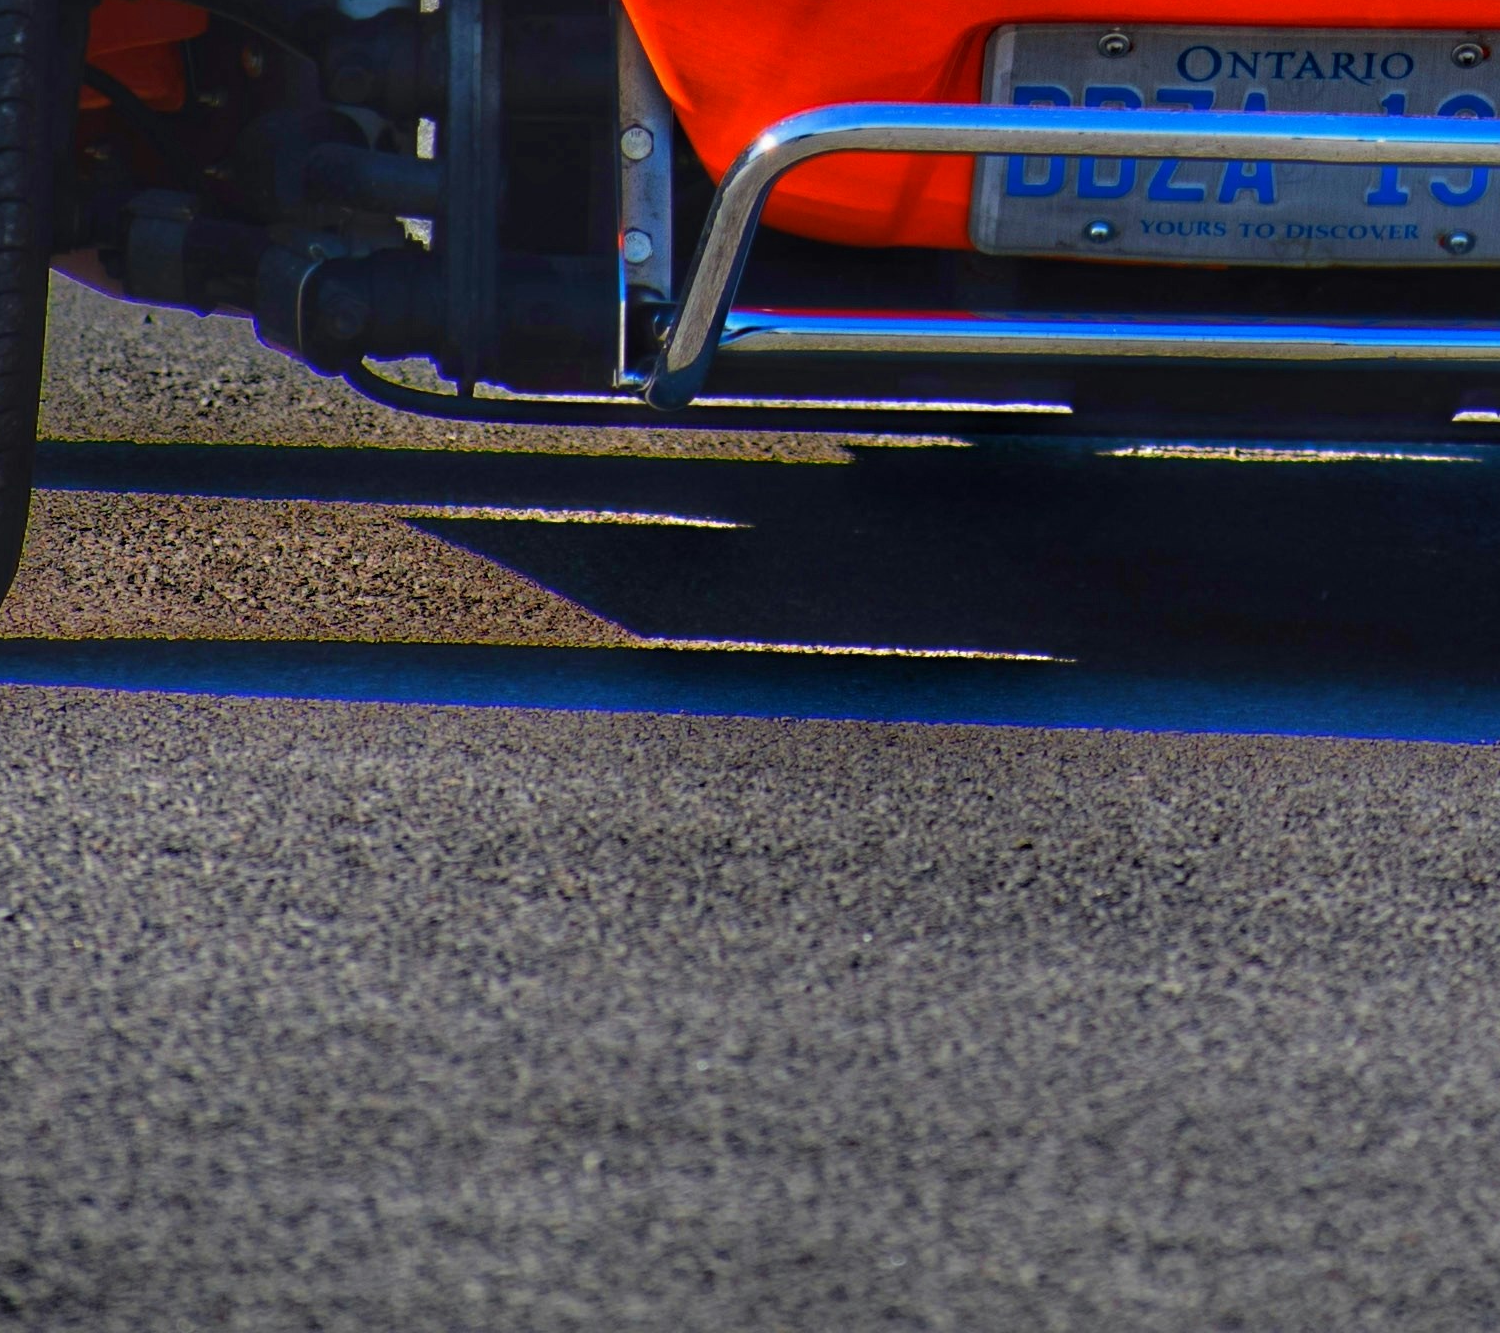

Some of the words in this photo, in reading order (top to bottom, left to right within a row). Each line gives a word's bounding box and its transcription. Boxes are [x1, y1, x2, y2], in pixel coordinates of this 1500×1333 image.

[1140, 219, 1227, 237] YOURS
[1239, 222, 1275, 239] TO
[1286, 223, 1419, 241] DISCOVER
